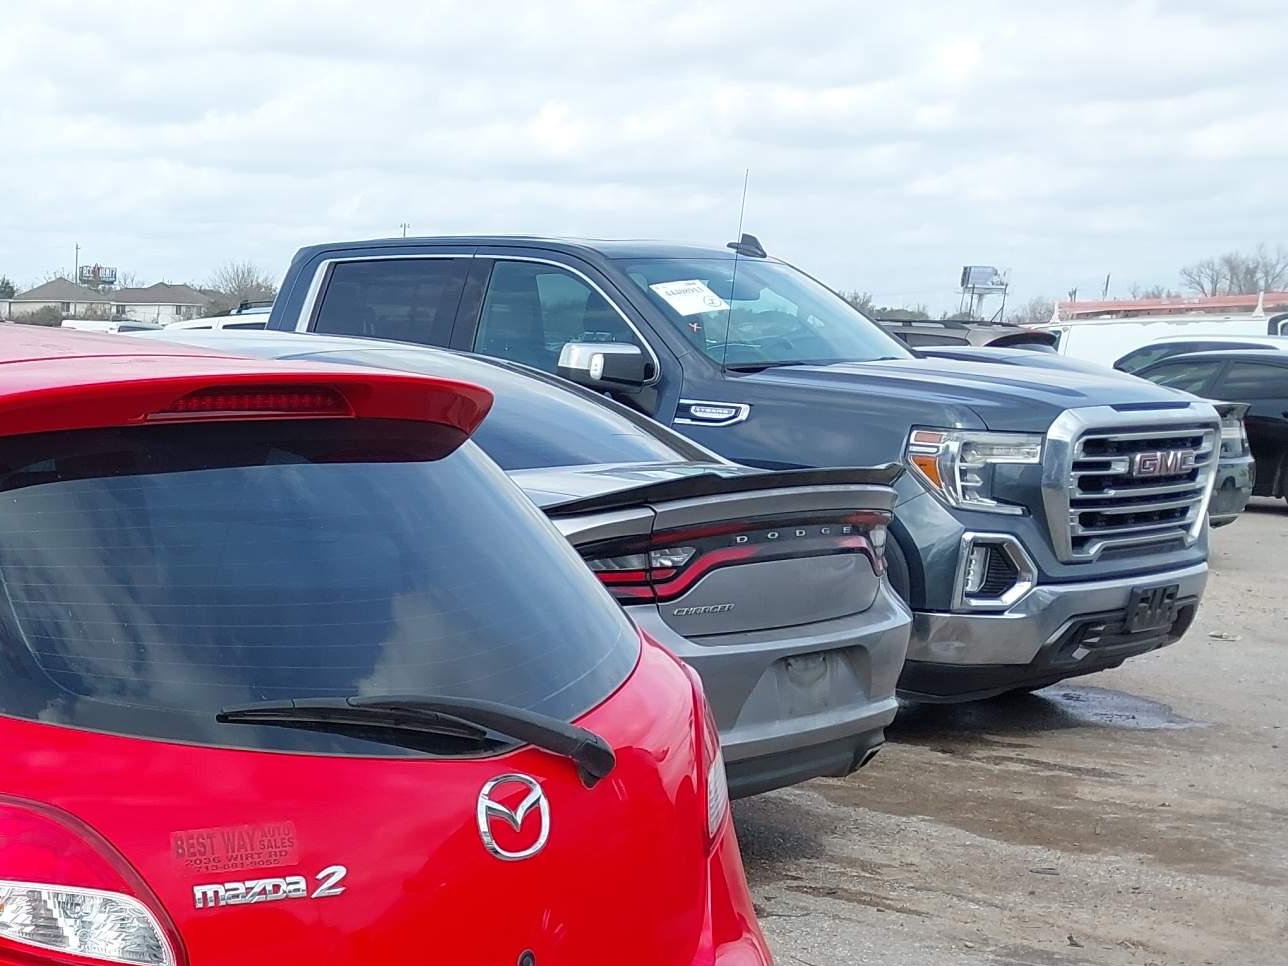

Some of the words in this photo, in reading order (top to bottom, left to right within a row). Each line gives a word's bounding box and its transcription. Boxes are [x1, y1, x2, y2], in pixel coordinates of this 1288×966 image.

[1133, 449, 1194, 477] GMC
[735, 526, 852, 544] DODGE
[672, 603, 736, 616] CHARGER
[261, 824, 291, 838] AUTO
[174, 833, 217, 859] BEST
[223, 829, 258, 854] WAY
[259, 837, 295, 851] SALES
[184, 856, 222, 867] 2036
[226, 852, 263, 862] WIRT
[310, 864, 348, 899] 2
